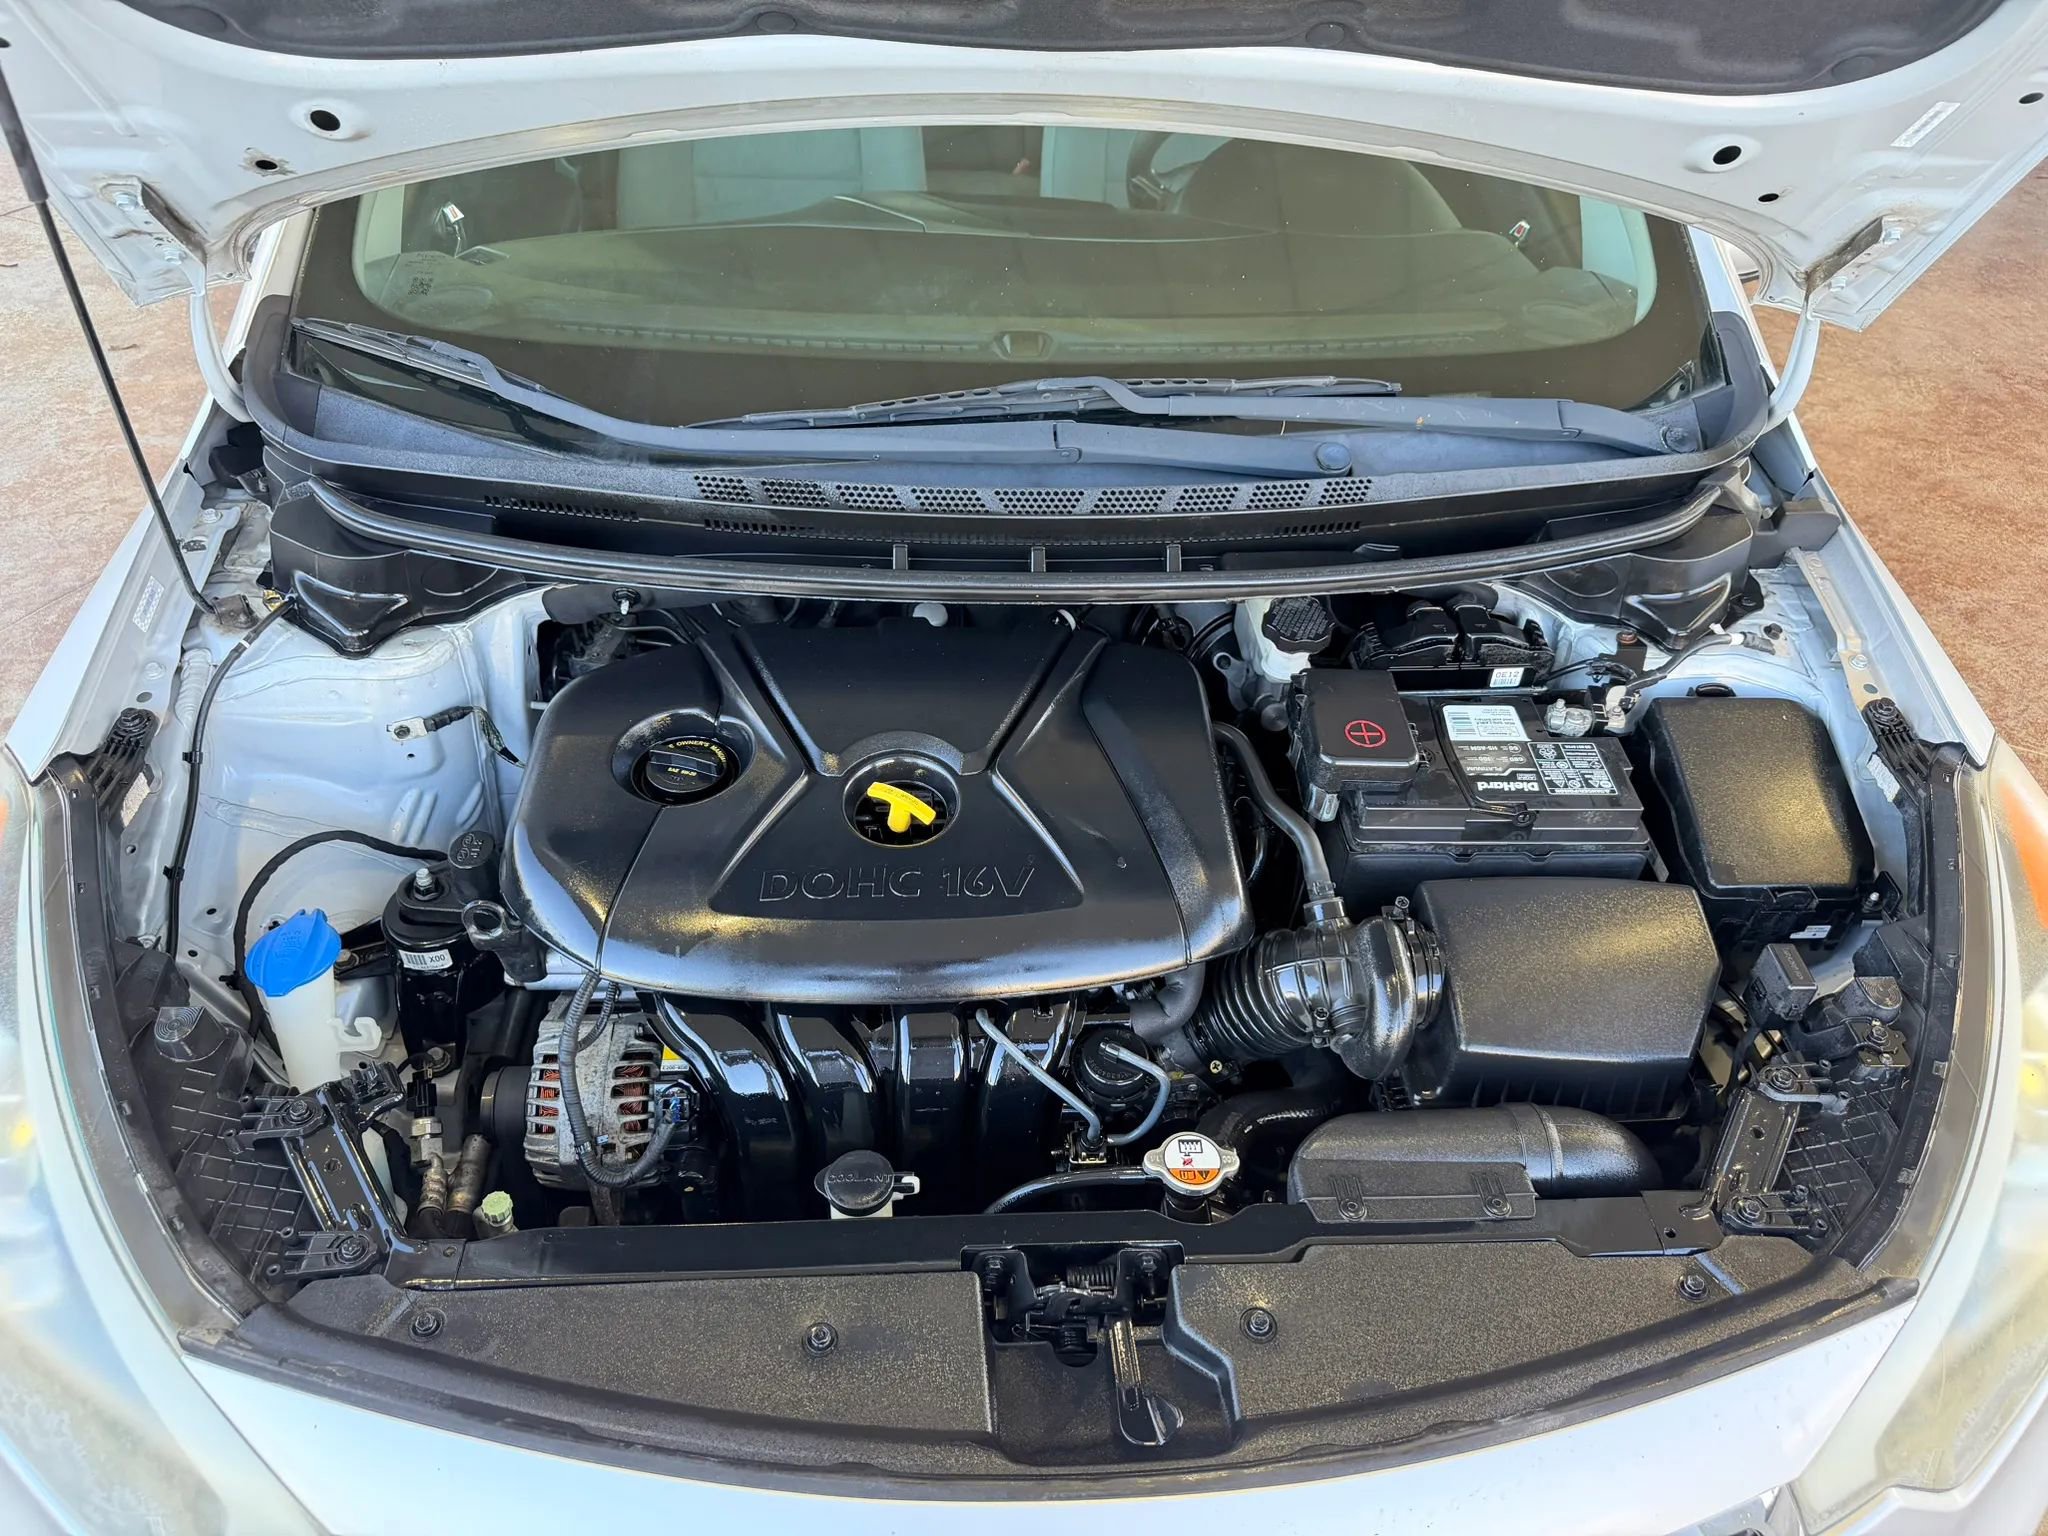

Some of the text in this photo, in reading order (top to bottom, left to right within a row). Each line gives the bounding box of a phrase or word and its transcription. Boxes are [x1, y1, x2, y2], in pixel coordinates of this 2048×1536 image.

[1476, 781, 1540, 792] DieHard
[759, 864, 1036, 902] DOHC 16V
[827, 1173, 893, 1184] COOLANT
